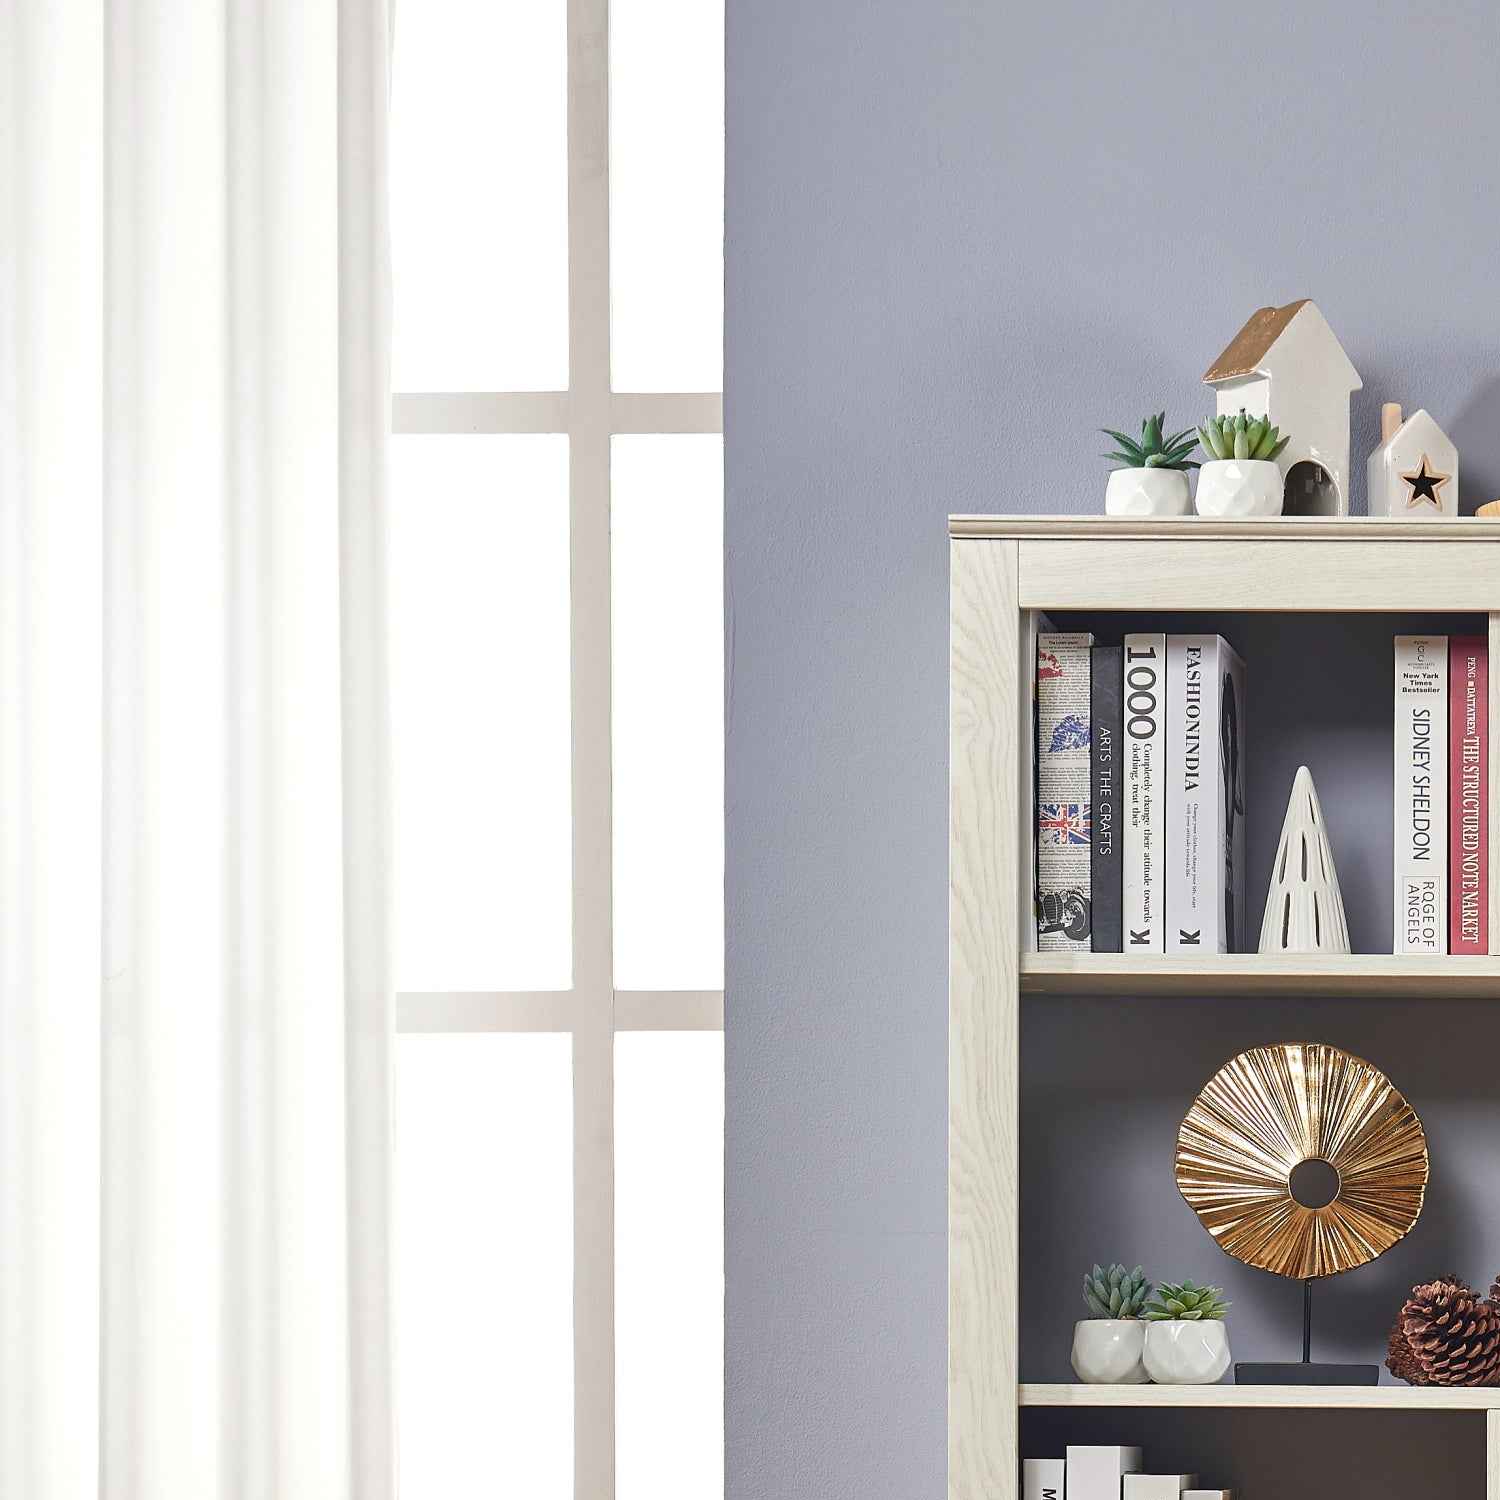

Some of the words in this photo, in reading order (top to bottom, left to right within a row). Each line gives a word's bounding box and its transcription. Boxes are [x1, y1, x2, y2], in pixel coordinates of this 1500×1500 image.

[1467, 657, 1475, 678] PENG
[1127, 647, 1156, 739] 1000
[1184, 647, 1201, 792] FASHIONINDIA
[1466, 688, 1475, 735] DATTATREYA
[1100, 727, 1111, 761] ARTS
[1412, 709, 1430, 771] SIDNEY
[1462, 737, 1479, 763] THE
[1130, 744, 1141, 779] clothing,
[1141, 744, 1152, 791] Completely
[1100, 768, 1111, 796] THE
[1132, 785, 1140, 806] treat
[1132, 809, 1141, 828] their
[1141, 795, 1152, 825] change
[1412, 776, 1430, 861] SHELDON
[1461, 765, 1479, 849] STRUCTURED
[1100, 803, 1111, 855] CRAFTS
[1143, 829, 1152, 849] their
[1143, 852, 1152, 885] attitude
[1461, 852, 1479, 889] NOTE
[1143, 889, 1152, 922] towards
[1408, 885, 1420, 944] ANGELS
[1422, 882, 1434, 925] RQGE
[1461, 891, 1478, 943] NARKET
[1422, 928, 1434, 947] OF
